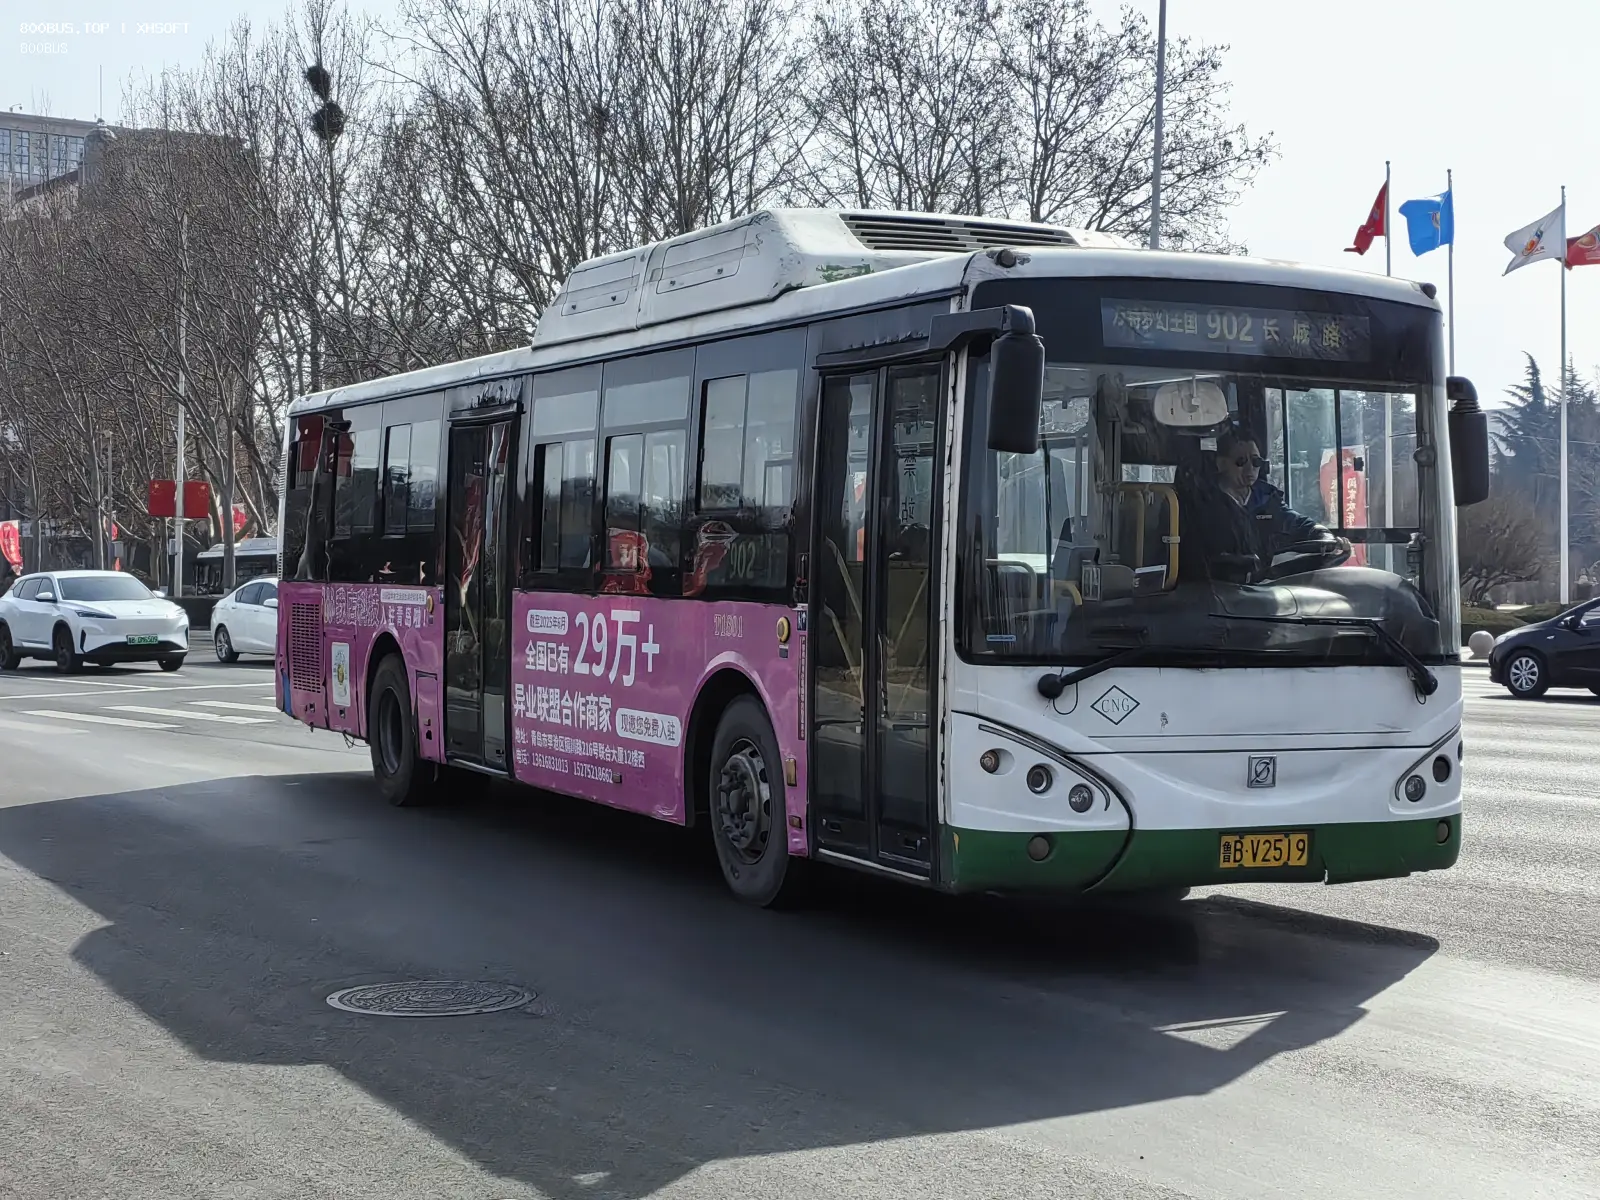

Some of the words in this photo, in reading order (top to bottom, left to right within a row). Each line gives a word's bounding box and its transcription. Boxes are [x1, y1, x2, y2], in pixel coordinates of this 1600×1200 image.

[1206, 308, 1254, 343] 902
[729, 540, 756, 579] 902
[525, 640, 570, 675] 全国已有
[573, 609, 660, 687] 29万+
[513, 683, 612, 733] 异业联盟合作商家
[1101, 698, 1131, 714] CNG
[621, 713, 676, 742] 现邀您免费入驻
